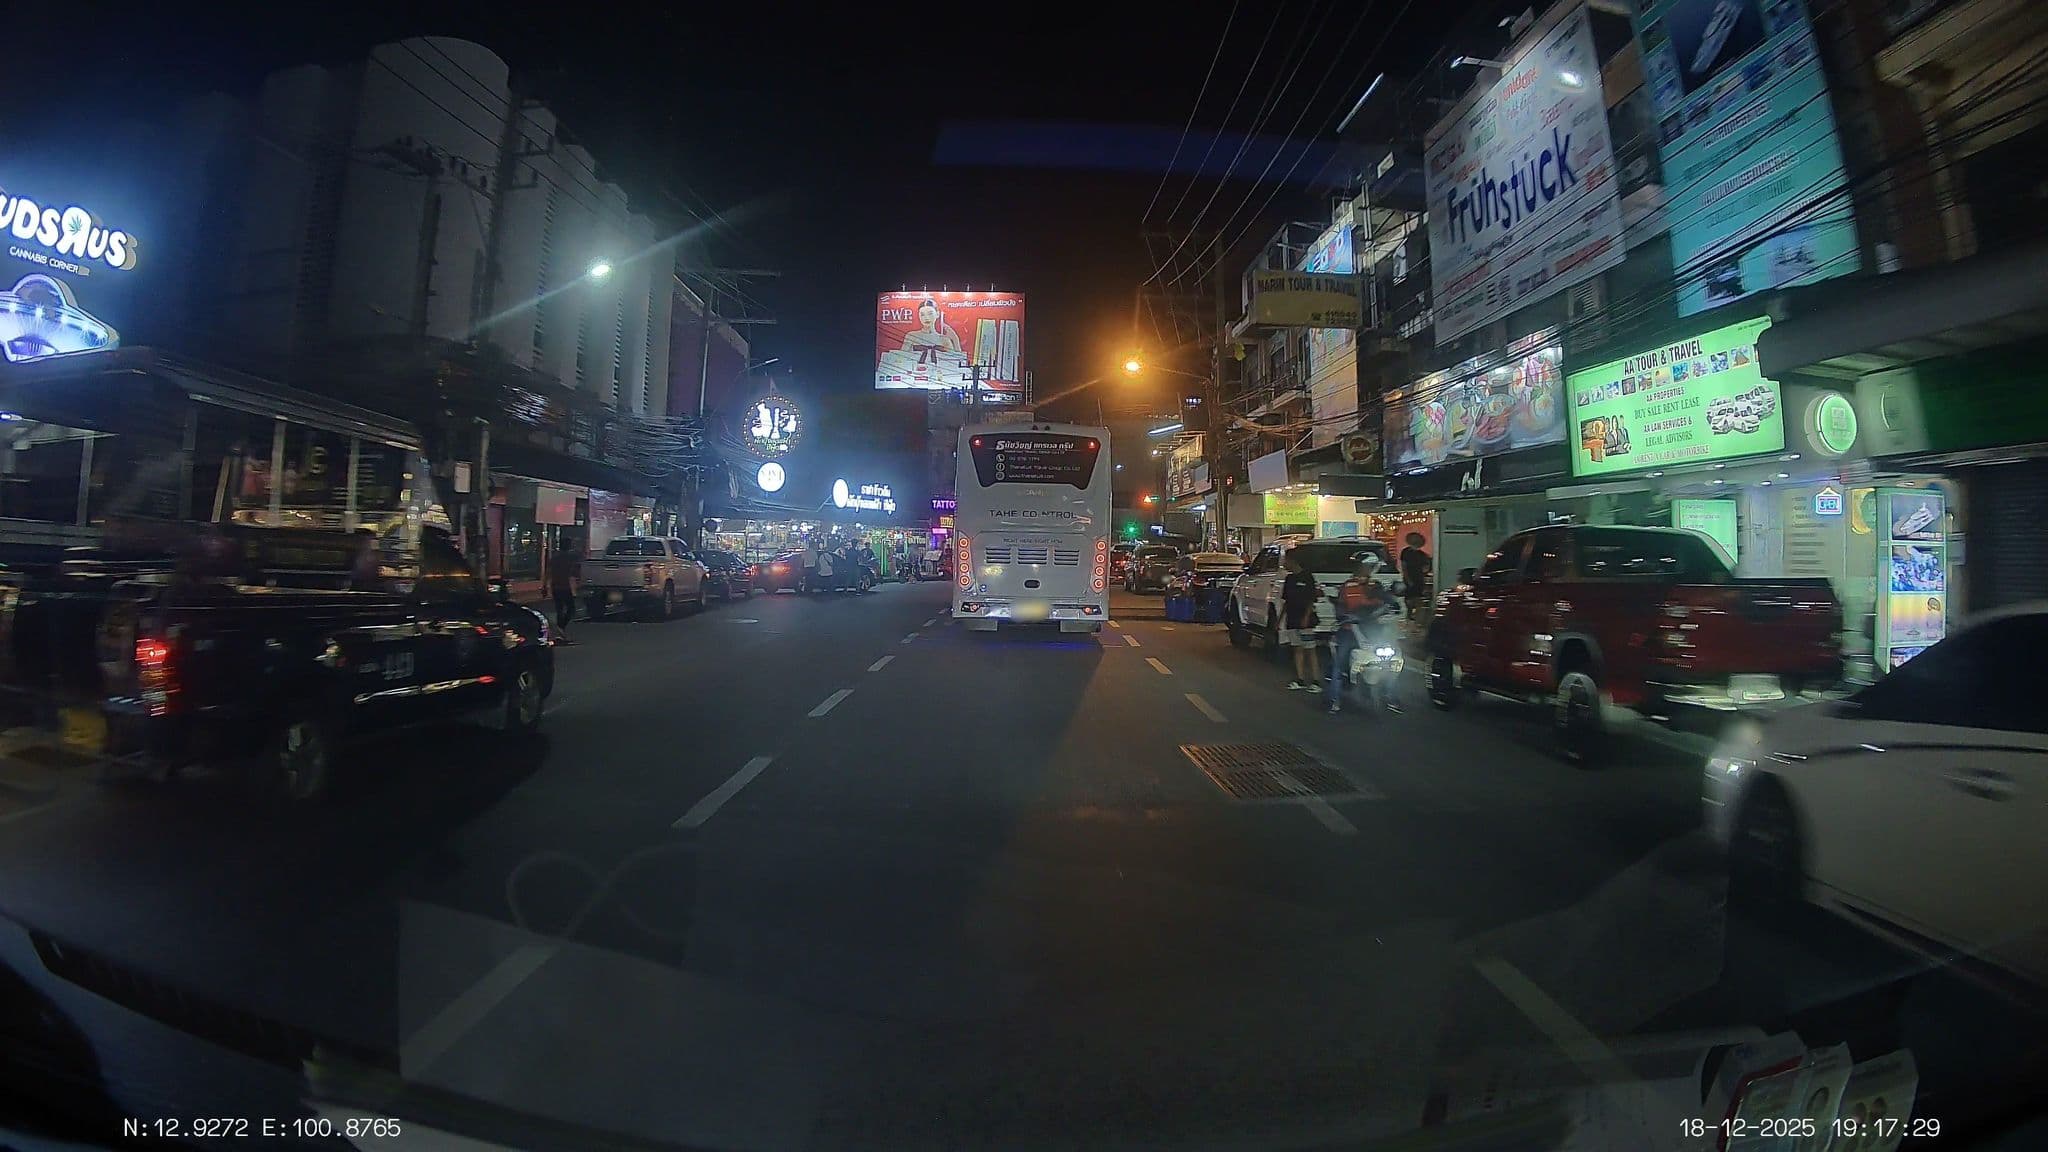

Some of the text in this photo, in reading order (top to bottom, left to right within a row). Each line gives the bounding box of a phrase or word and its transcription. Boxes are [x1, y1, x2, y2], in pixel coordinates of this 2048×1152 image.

[1448, 127, 1577, 243] Frühstück
[9, 246, 79, 273] CANNABIS CORNER
[1288, 277, 1313, 291] TOUR
[882, 307, 913, 321] PWP
[1624, 339, 1703, 376] AA TOUR & TRAVEL
[1653, 387, 1685, 400] PROPERTIES
[1634, 397, 1701, 420] BUY SALE RENT LEASE
[1651, 422, 1662, 432] LAW
[1663, 417, 1687, 430] SERVICES
[1645, 430, 1693, 447] LEGAL ADVISORS
